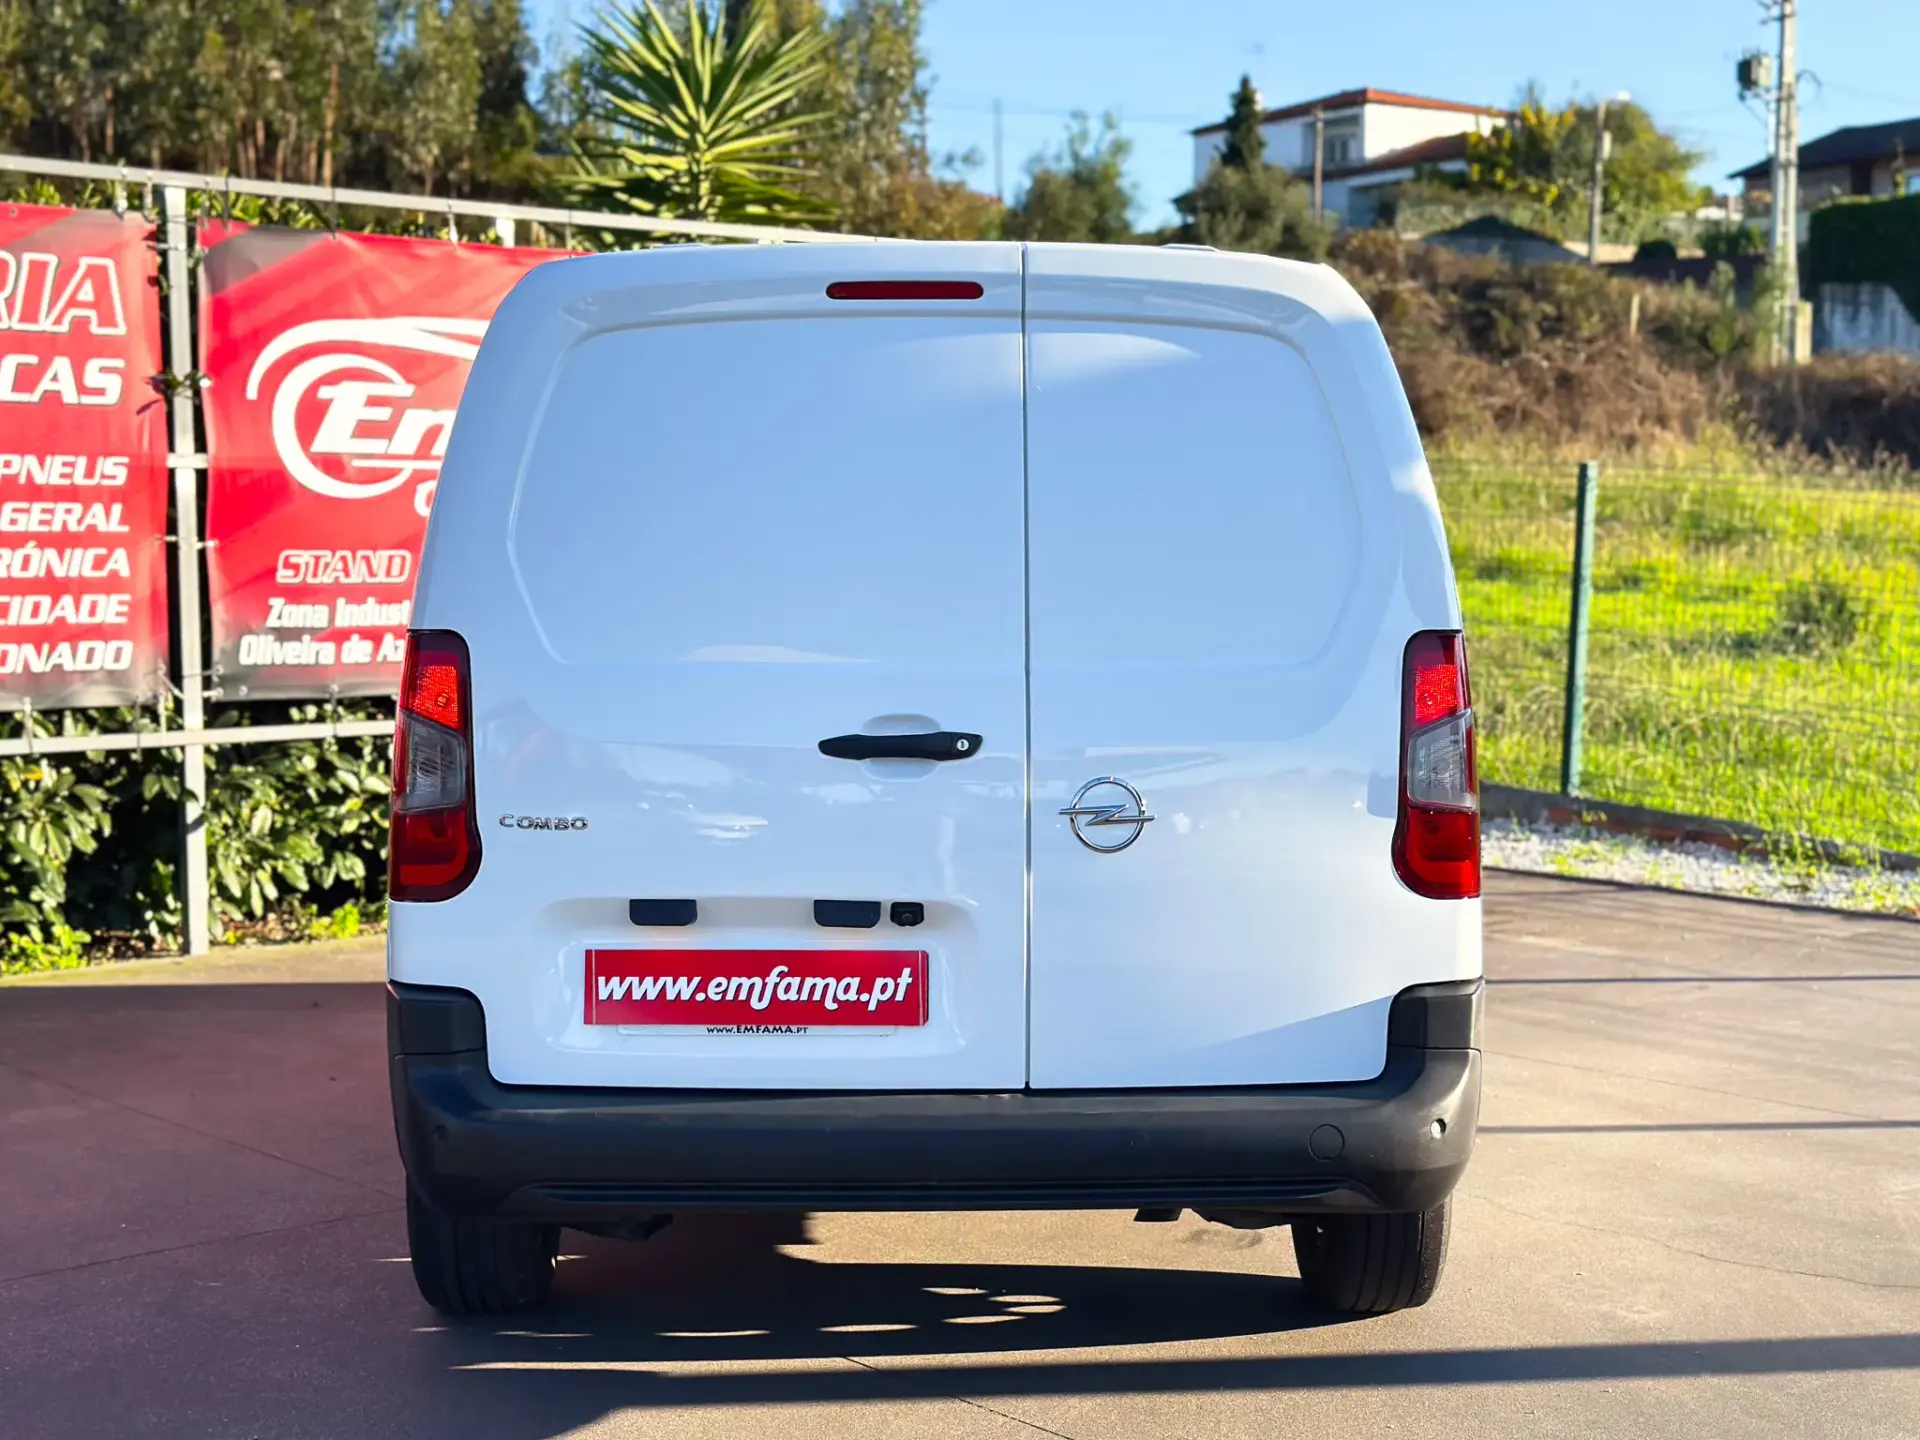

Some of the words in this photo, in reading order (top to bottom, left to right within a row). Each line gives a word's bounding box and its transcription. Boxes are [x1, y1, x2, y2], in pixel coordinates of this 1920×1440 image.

[0, 251, 128, 335] IA
[0, 354, 126, 405] CAS
[0, 454, 130, 486] PNEUS
[0, 501, 130, 532] GERAL
[276, 550, 412, 584] STAND
[265, 597, 330, 628] Zona
[239, 633, 336, 665] Oliveira
[341, 633, 374, 664] de
[499, 813, 588, 831] COMBO
[597, 965, 914, 1011] www.emfama.pt
